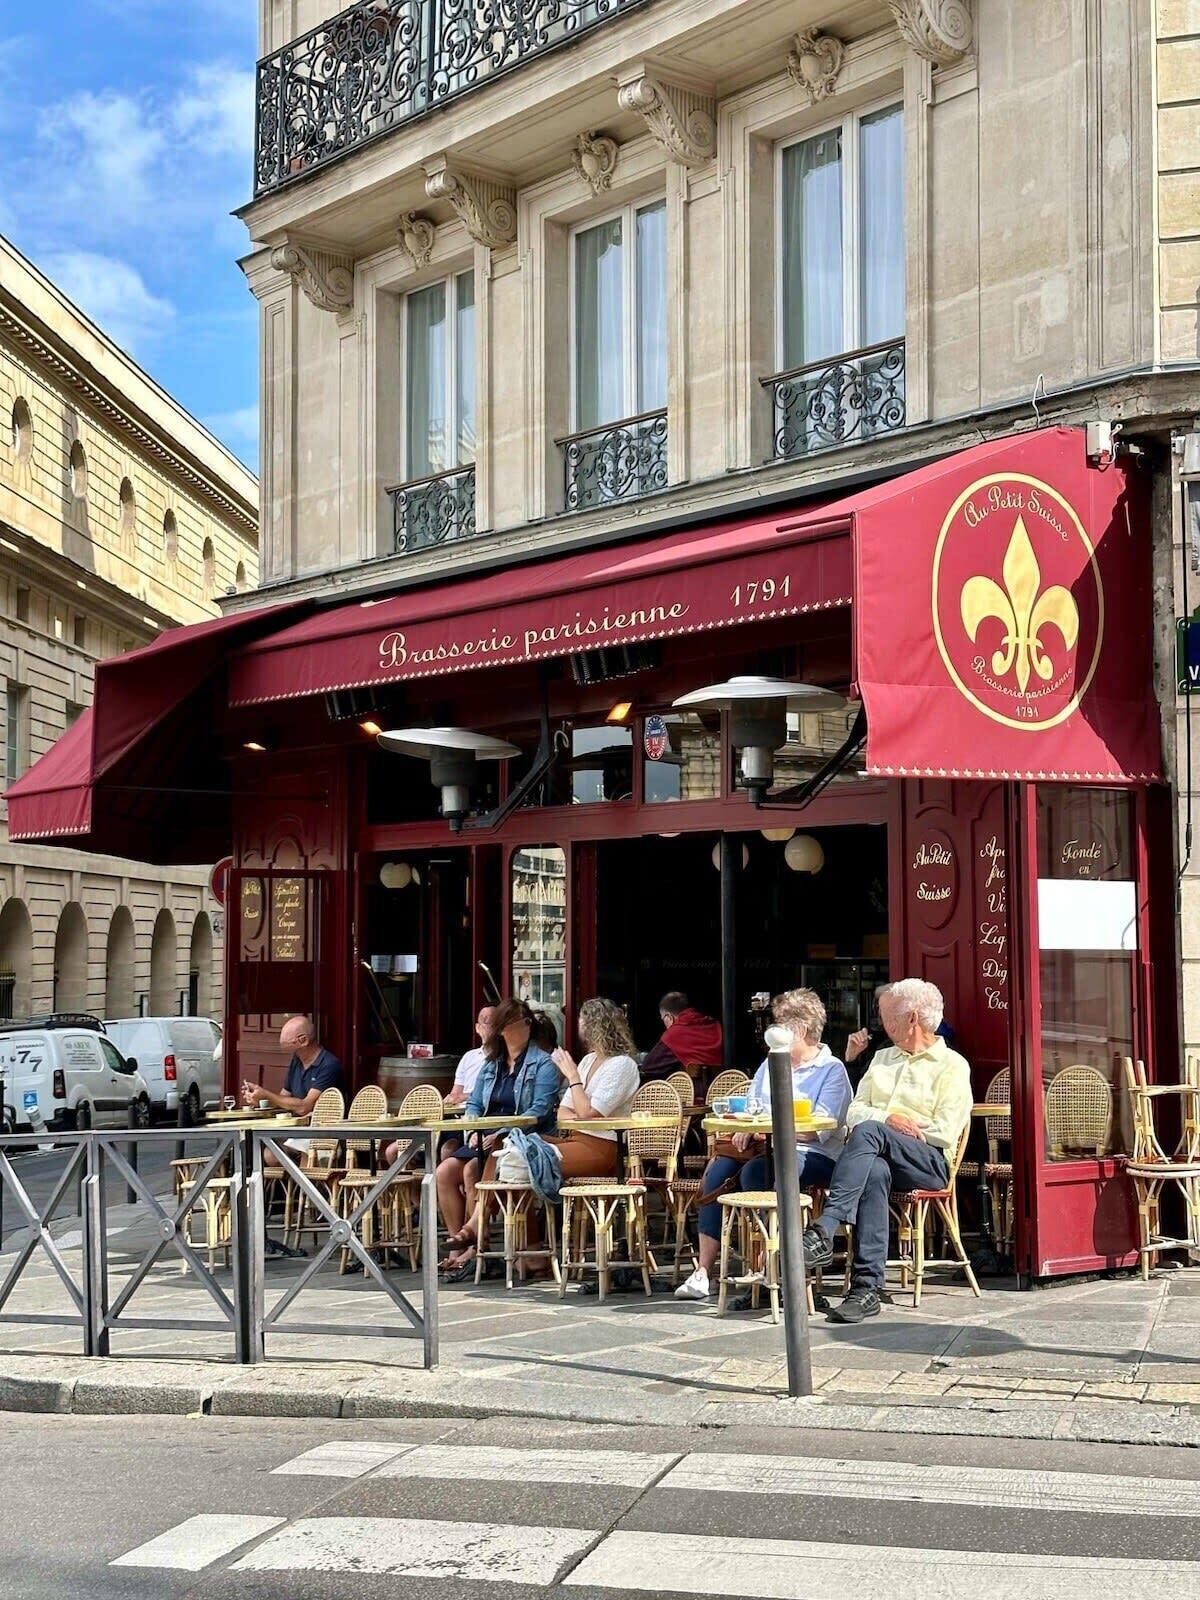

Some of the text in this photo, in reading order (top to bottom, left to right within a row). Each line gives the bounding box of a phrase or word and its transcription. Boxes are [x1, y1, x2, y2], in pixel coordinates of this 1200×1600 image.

[964, 485, 1069, 541] Au Petit Suisse
[730, 575, 791, 608] 1791
[379, 602, 690, 669] Brasserie parisienne
[971, 656, 1073, 704] Brasserie parisienne
[1188, 665, 1200, 680] V
[1016, 706, 1039, 717] 1791
[913, 843, 952, 869] Au Petit
[1061, 840, 1101, 863] Fondé
[1079, 864, 1092, 874] en
[917, 882, 951, 900] Suisse
